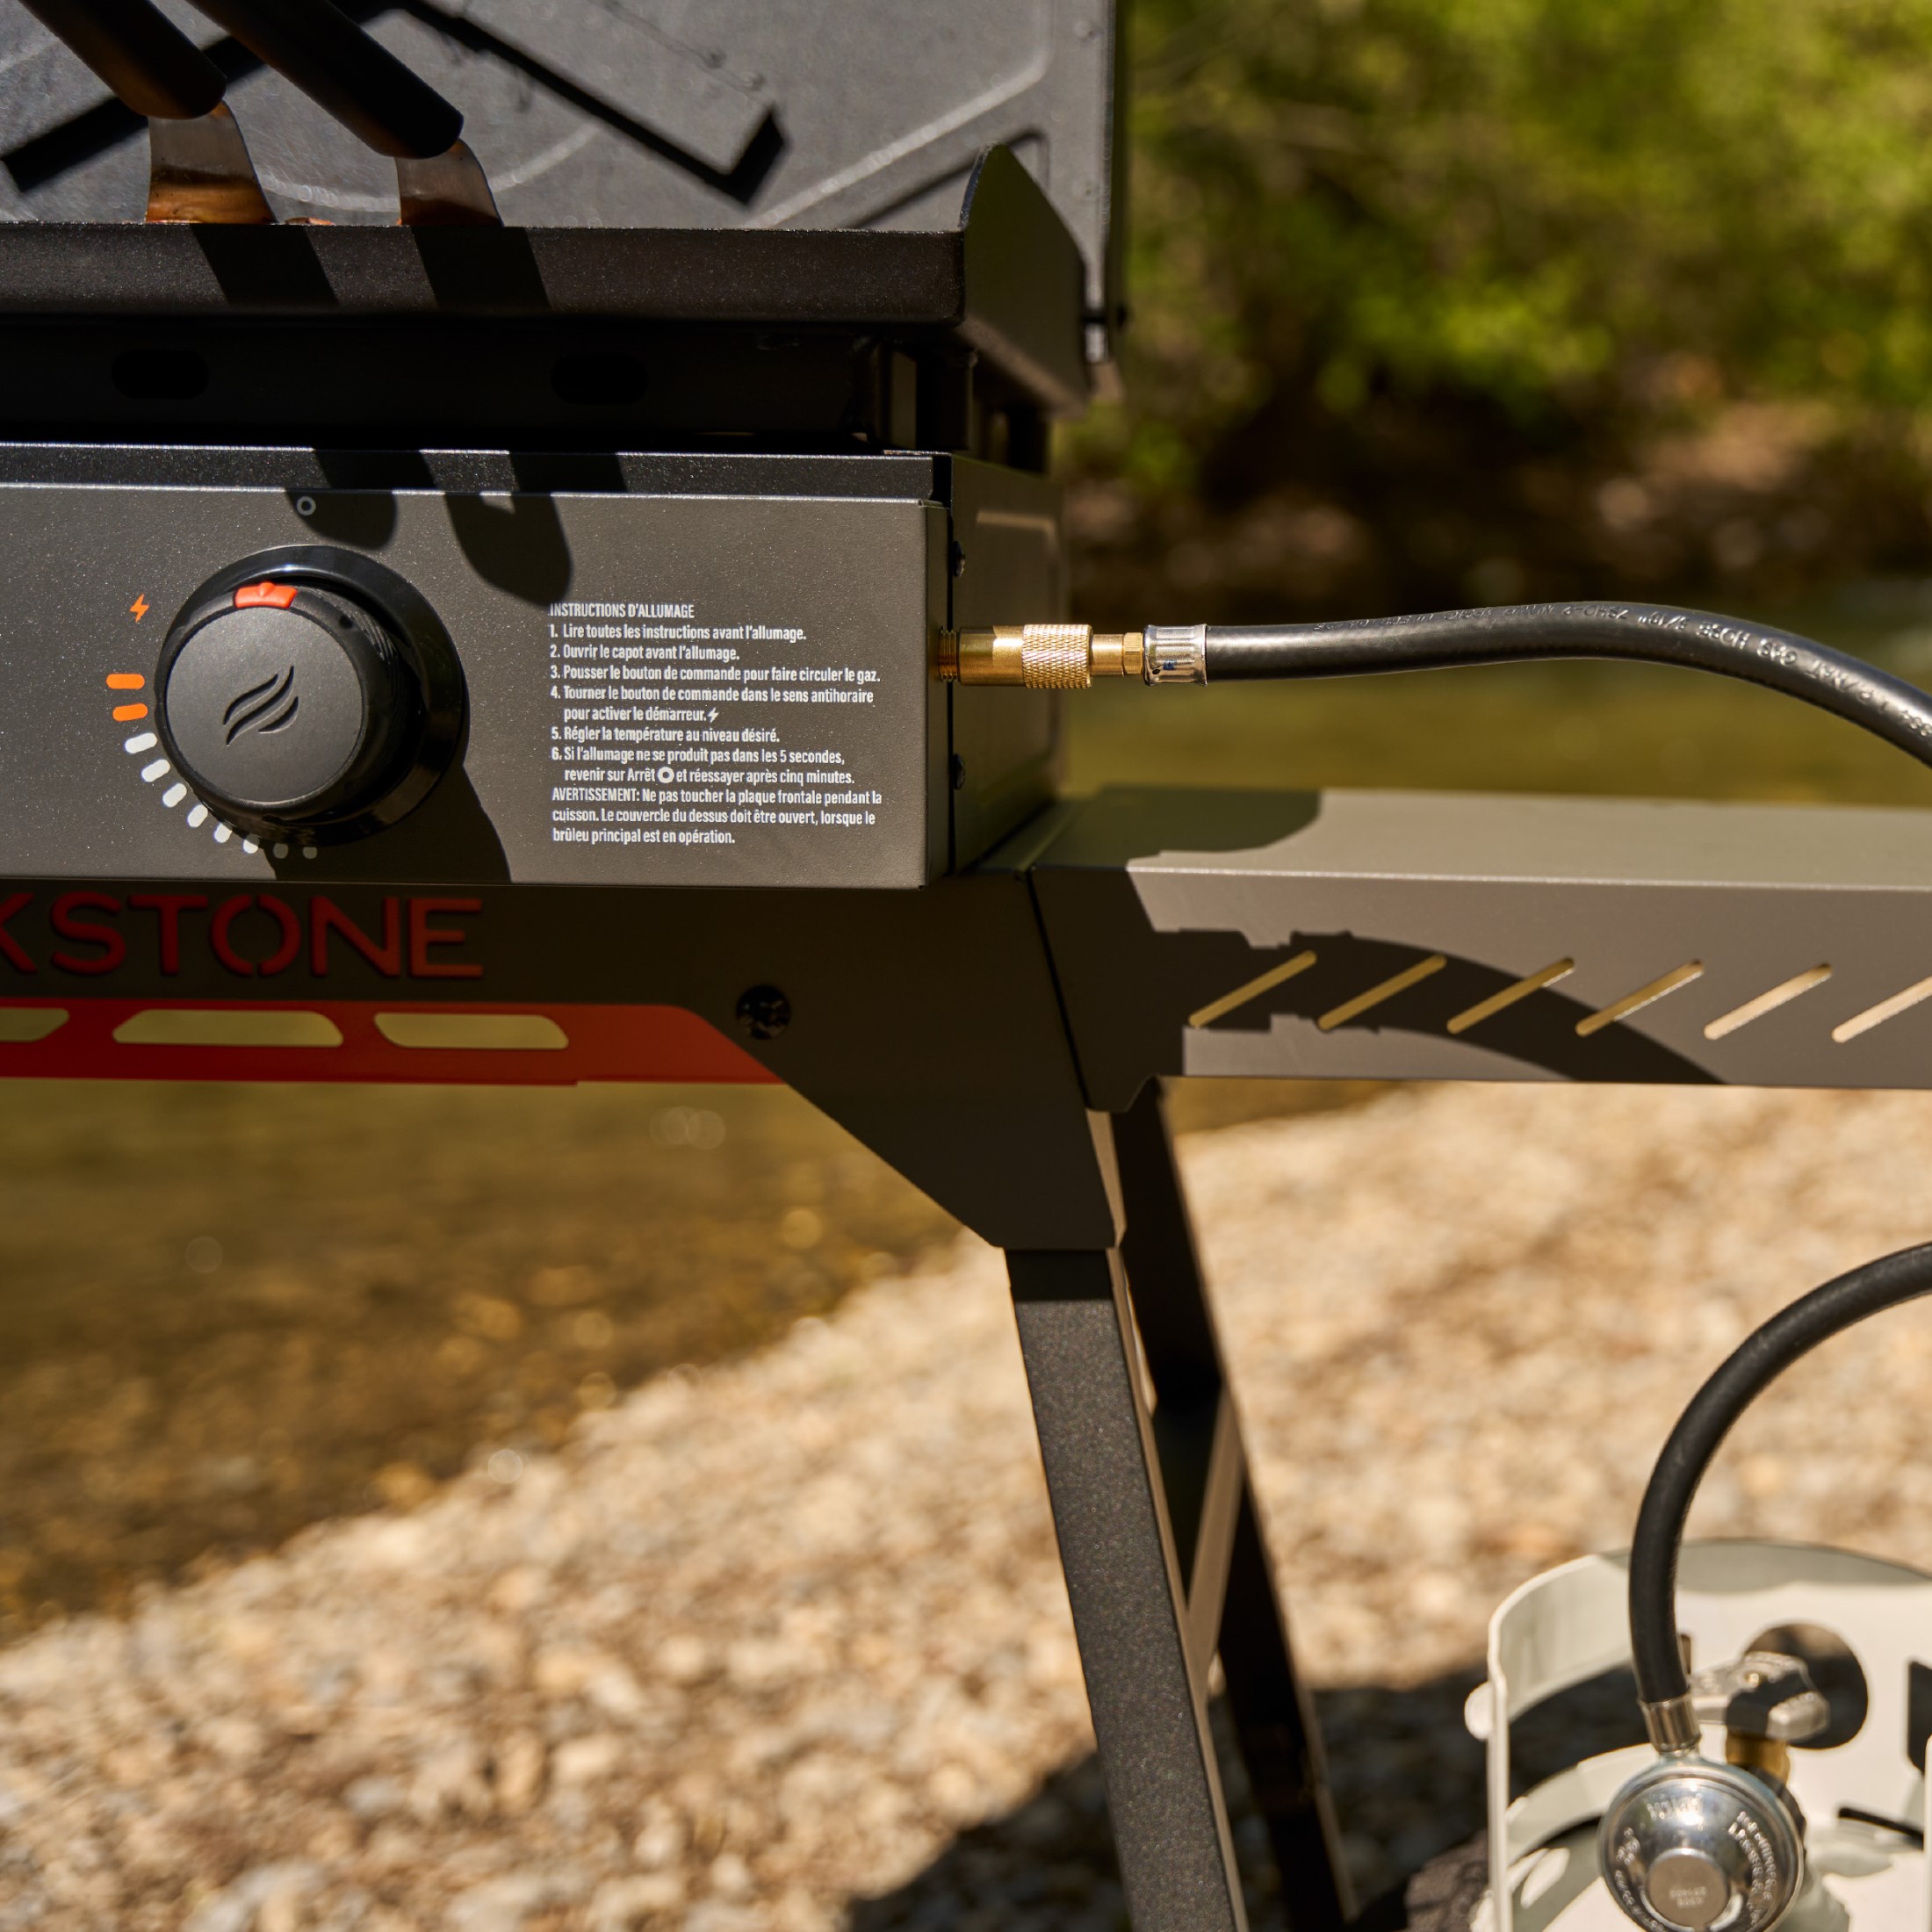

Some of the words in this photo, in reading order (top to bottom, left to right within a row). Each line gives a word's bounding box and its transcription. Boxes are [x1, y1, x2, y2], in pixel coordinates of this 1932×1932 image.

[550, 603, 626, 617] INSTRUCTIONS
[628, 603, 695, 618] D'ALLUMAGE
[550, 624, 559, 638] 1.
[563, 624, 584, 638] Lire
[586, 624, 622, 638] toutes
[624, 624, 641, 638] les
[642, 624, 710, 638] instructions
[712, 626, 744, 639] avant
[746, 625, 806, 643] l'allumage.
[550, 644, 560, 658] 2.
[563, 644, 598, 658] Ouvrir
[599, 645, 610, 658] le
[611, 646, 644, 661] capot
[645, 646, 678, 659] avant
[679, 645, 739, 663] l'allumage.
[551, 665, 562, 679] 3.
[563, 665, 609, 679] Pousser
[609, 665, 621, 679] le
[623, 665, 662, 679] bouton
[664, 666, 678, 680] de
[680, 667, 741, 680] commande
[744, 669, 770, 684] pour
[771, 667, 797, 681] faire
[799, 667, 843, 681] circuler
[845, 667, 855, 681] le
[857, 670, 880, 684] gaz.
[551, 685, 561, 698] 4.
[563, 685, 607, 699] Tourner
[608, 686, 619, 699] le
[621, 686, 661, 700] bouton
[662, 687, 677, 700] de
[678, 688, 739, 701] commande
[741, 688, 768, 702] dans
[770, 688, 782, 702] le
[782, 691, 809, 703] sens
[811, 688, 873, 703] antihoraire
[564, 709, 591, 723] pour
[592, 706, 631, 720] activer
[632, 706, 644, 720] le
[645, 706, 707, 721] démarreur.
[551, 726, 562, 739] 5.
[564, 726, 601, 743] Régler
[602, 726, 613, 740] la
[614, 727, 684, 743] température
[686, 731, 700, 741] au
[702, 727, 740, 741] niveau
[742, 727, 780, 742] désiré.
[551, 746, 563, 760] 6.
[564, 746, 574, 761] Si
[576, 746, 635, 764] l'allumage
[636, 751, 651, 761] ne
[652, 751, 665, 761] se
[667, 747, 708, 764] produit
[710, 751, 730, 765] pas
[732, 748, 760, 762] dans
[761, 749, 778, 762] les
[780, 750, 787, 762] 5
[789, 750, 845, 765] secondes,
[564, 768, 605, 781] revenir
[607, 770, 625, 781] sur
[627, 768, 655, 782] Arrêt
[676, 769, 688, 782] et
[689, 768, 745, 785] réessayer
[746, 768, 778, 786] après
[780, 769, 804, 787] cinq
[806, 770, 855, 783] minutes.
[552, 788, 640, 801] AVERTISSEMENT:
[642, 789, 657, 802] Ne
[659, 791, 679, 804] pas
[680, 789, 724, 802] toucher
[725, 789, 736, 803] la
[739, 789, 776, 806] plaque
[777, 789, 823, 804] frontale
[824, 790, 871, 806] pendant
[872, 790, 882, 804] la
[552, 808, 599, 821] cuisson.
[601, 808, 615, 821] Le
[616, 808, 670, 821] couvercle
[673, 809, 688, 822] du
[689, 809, 728, 823] dessus
[730, 810, 752, 823] doit
[753, 809, 777, 823] être
[779, 811, 818, 825] ouvert,
[820, 811, 863, 826] lorsque
[864, 811, 876, 825] le
[552, 827, 590, 841] brûleu
[591, 828, 641, 845] principal
[643, 830, 660, 842] est
[662, 832, 676, 842] en
[678, 829, 736, 846] opération.
